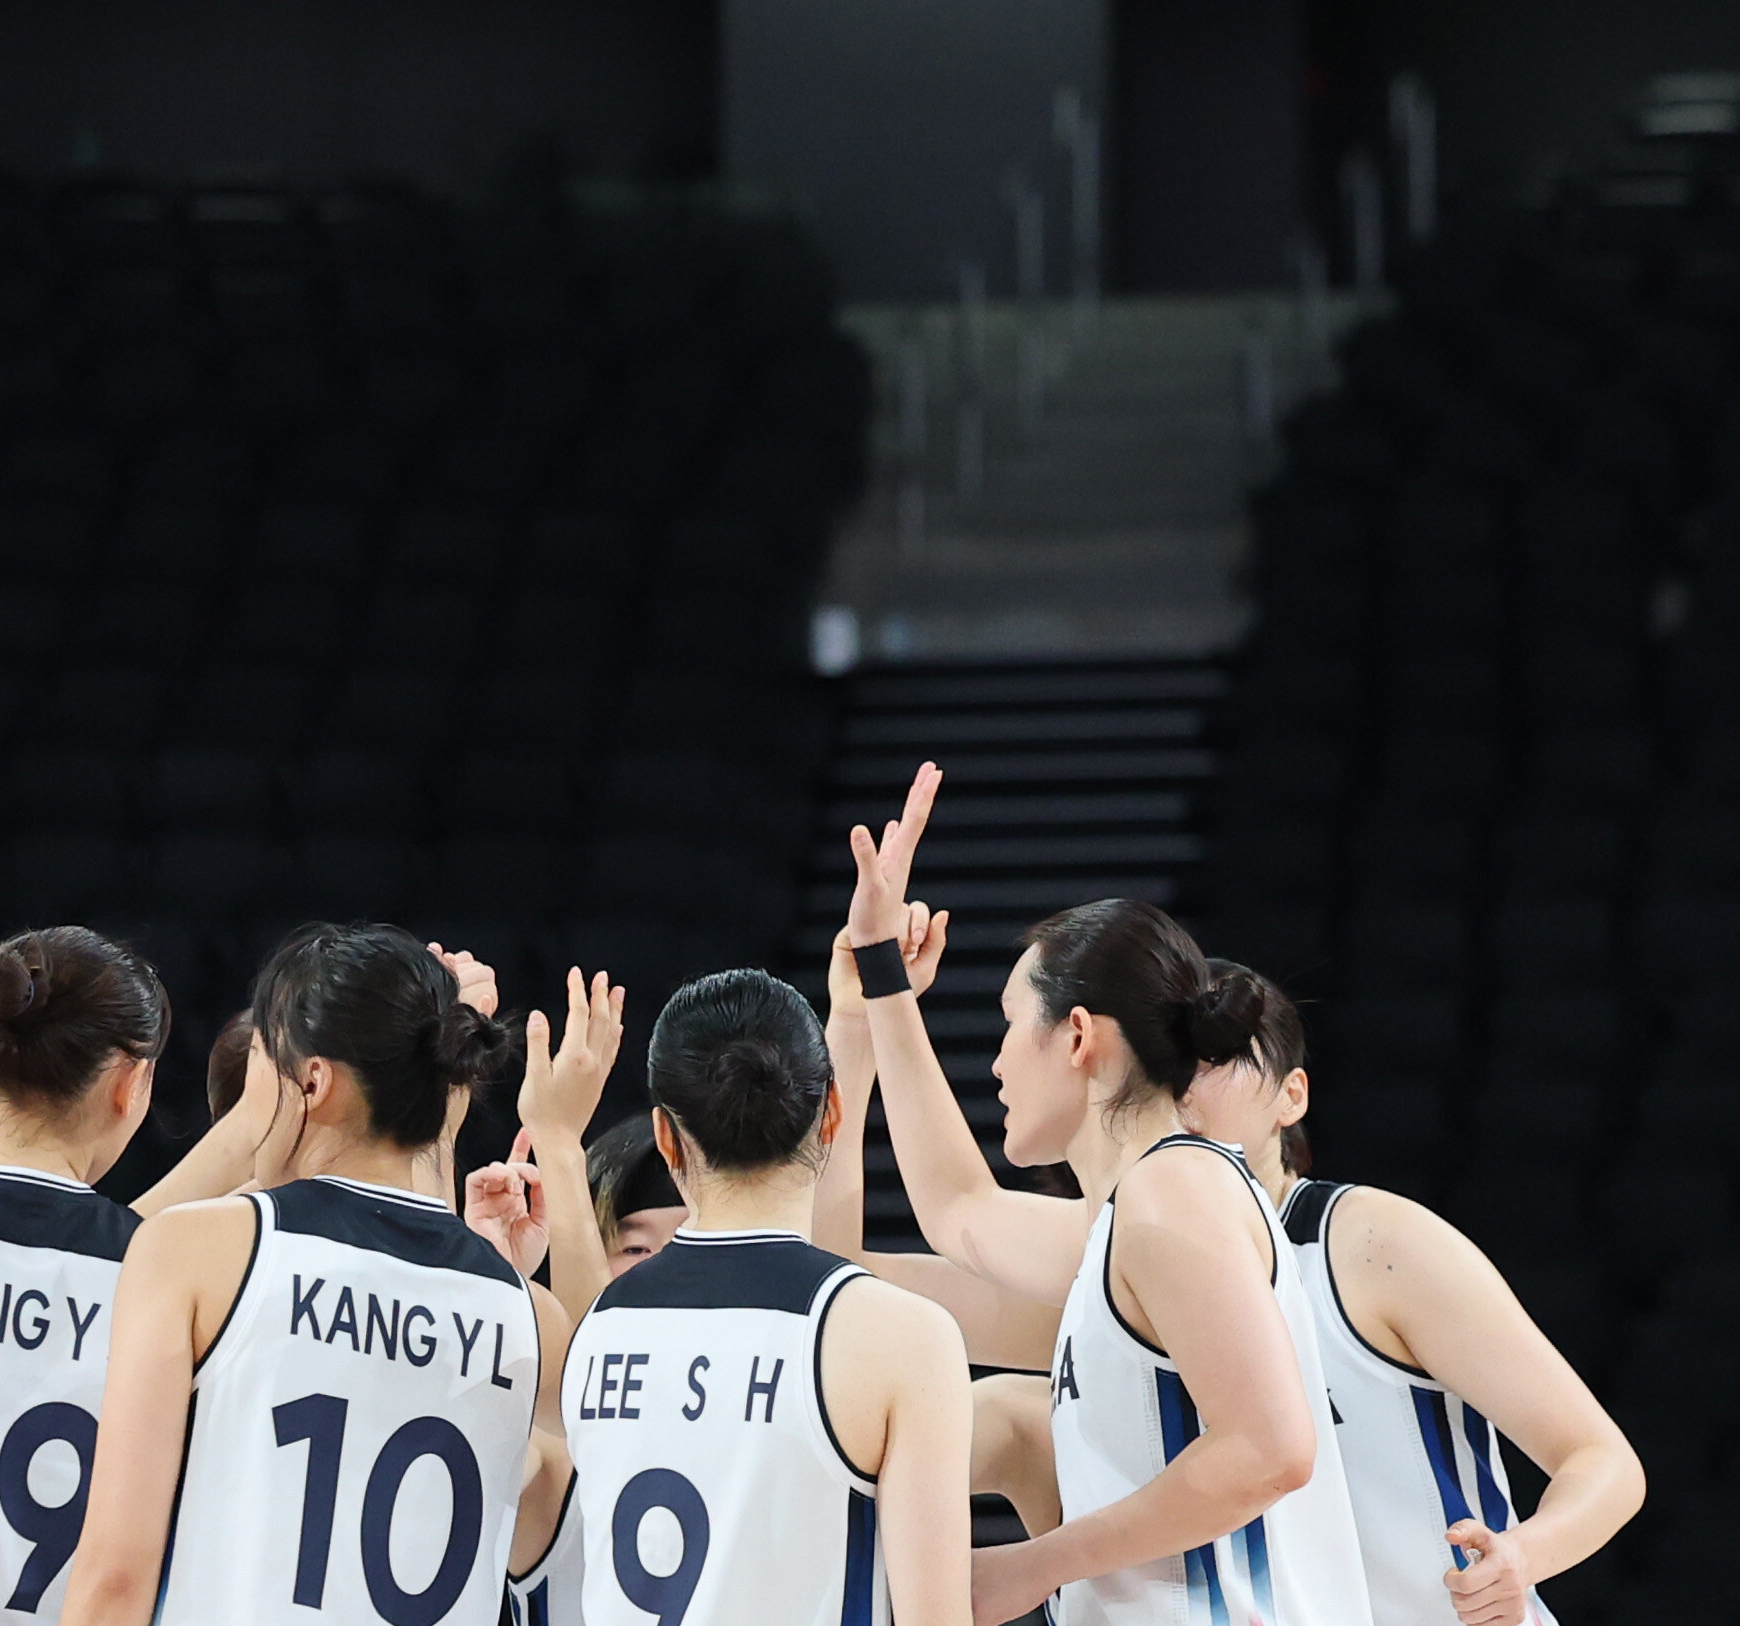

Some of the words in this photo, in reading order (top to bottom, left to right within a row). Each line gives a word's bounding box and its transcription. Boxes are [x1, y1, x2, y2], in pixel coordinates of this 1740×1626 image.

[65, 1296, 102, 1362] Y
[290, 1274, 438, 1368] KANG
[580, 1353, 650, 1421] LEE
[681, 1355, 711, 1422] S
[744, 1356, 785, 1424] H
